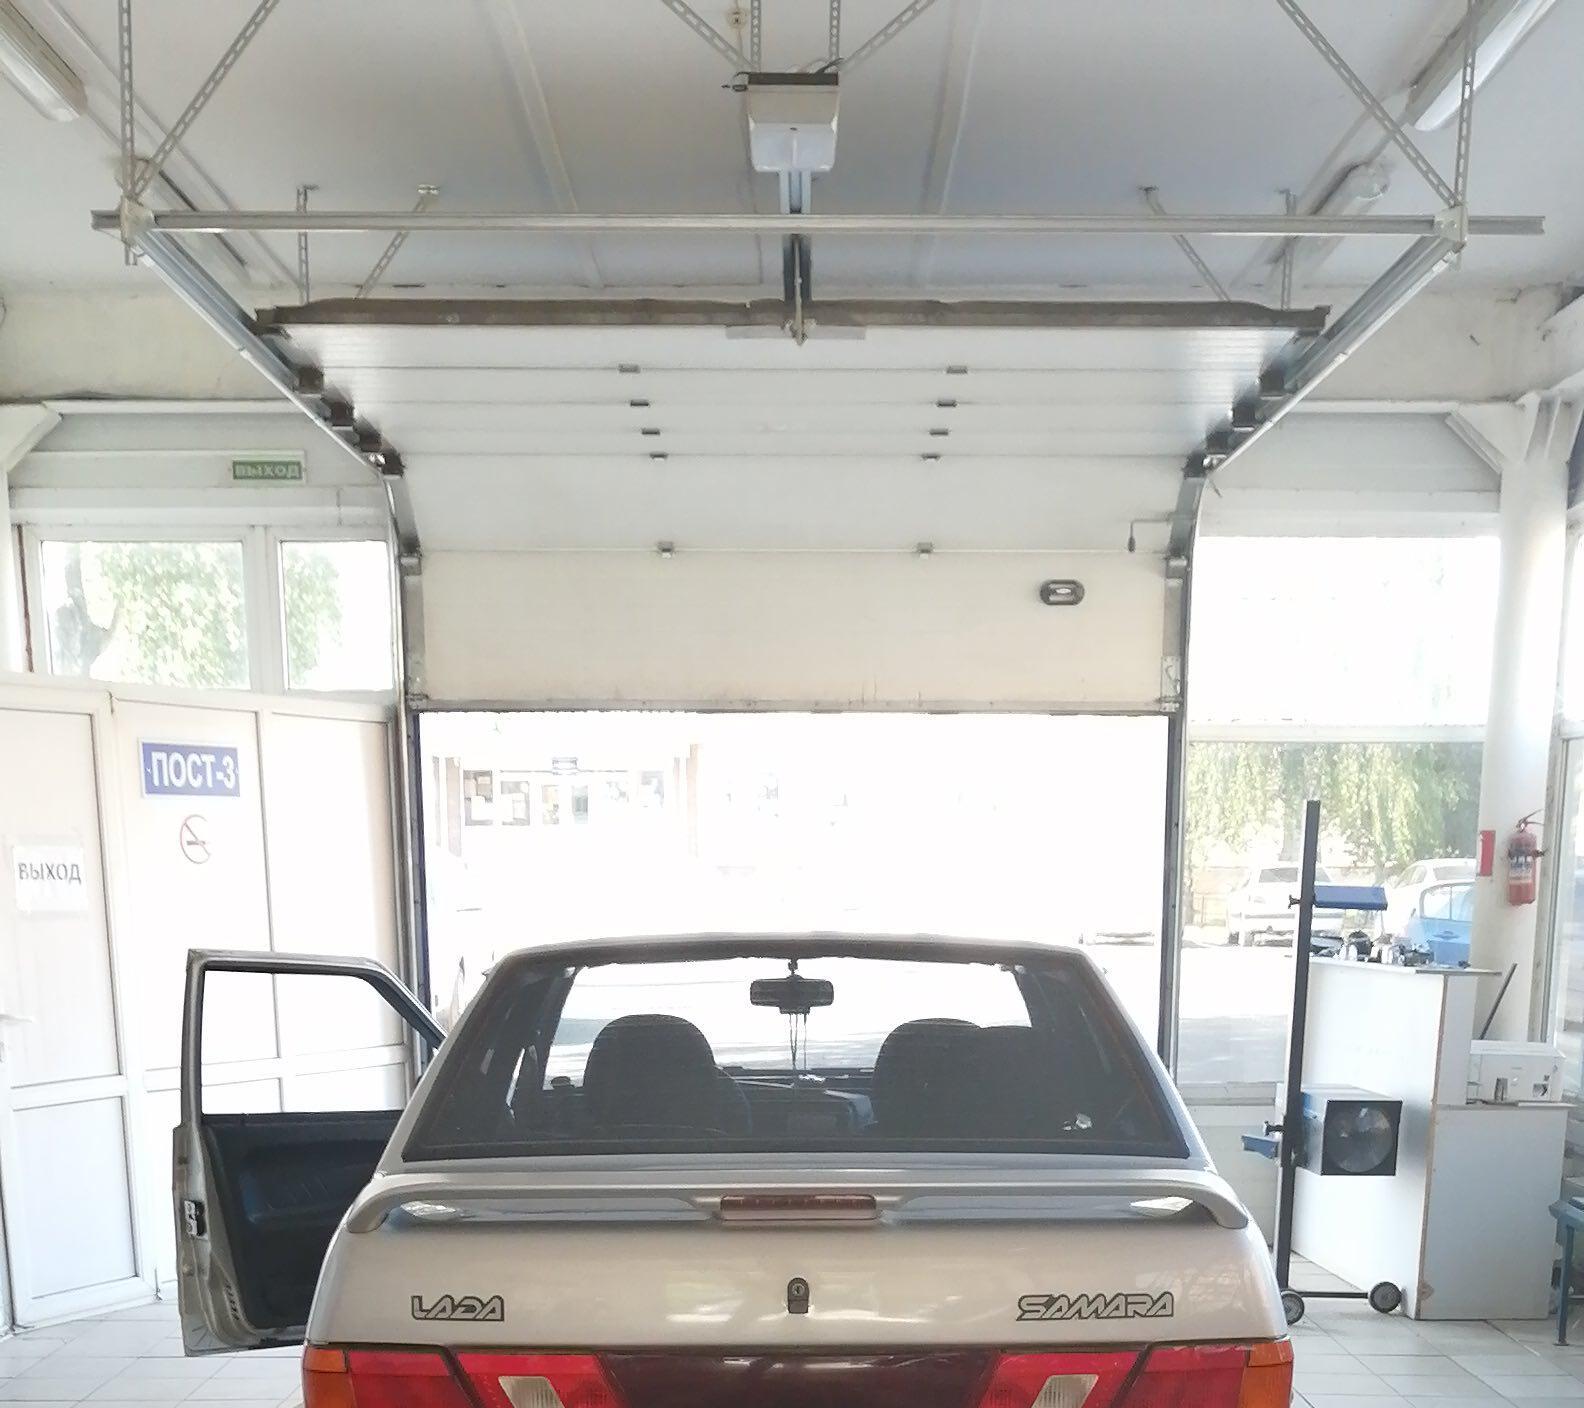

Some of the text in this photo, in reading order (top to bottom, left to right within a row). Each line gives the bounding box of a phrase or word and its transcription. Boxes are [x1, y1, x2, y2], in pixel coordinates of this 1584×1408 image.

[151, 751, 235, 789] ПОСТ-3
[18, 862, 82, 885] ВЫХОД
[411, 1294, 504, 1321] LADA
[1016, 1291, 1174, 1321] SAMARA
